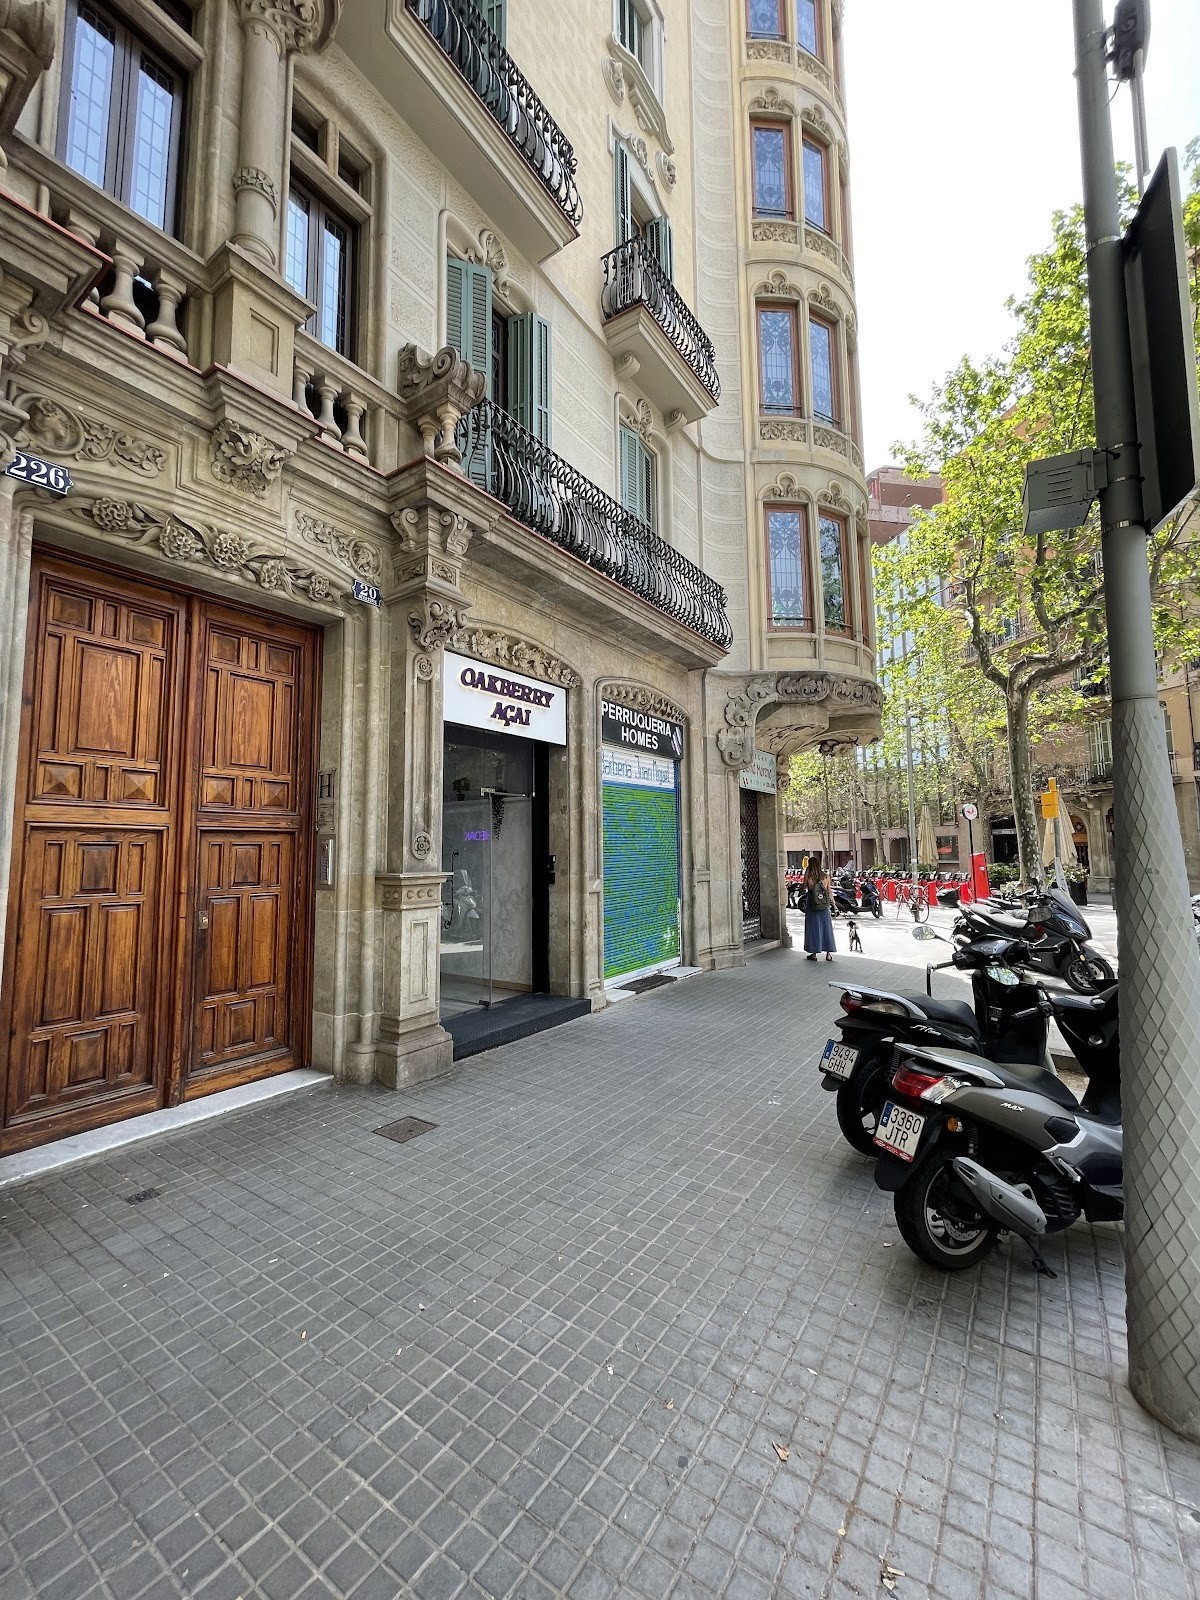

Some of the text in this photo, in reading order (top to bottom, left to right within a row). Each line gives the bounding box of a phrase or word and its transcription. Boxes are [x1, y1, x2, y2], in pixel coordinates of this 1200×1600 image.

[9, 453, 65, 489] 226
[360, 583, 377, 600] 20
[460, 667, 555, 708] OAKBERRY
[489, 701, 532, 726] AÇAI
[601, 701, 672, 737] PERRUQUERIA
[621, 725, 659, 750] HOMES
[827, 1057, 847, 1074] GHH
[833, 1045, 856, 1064] 9494
[1000, 1102, 1025, 1112] MAX
[890, 1107, 922, 1135] 3360
[885, 1125, 909, 1149] JTR
